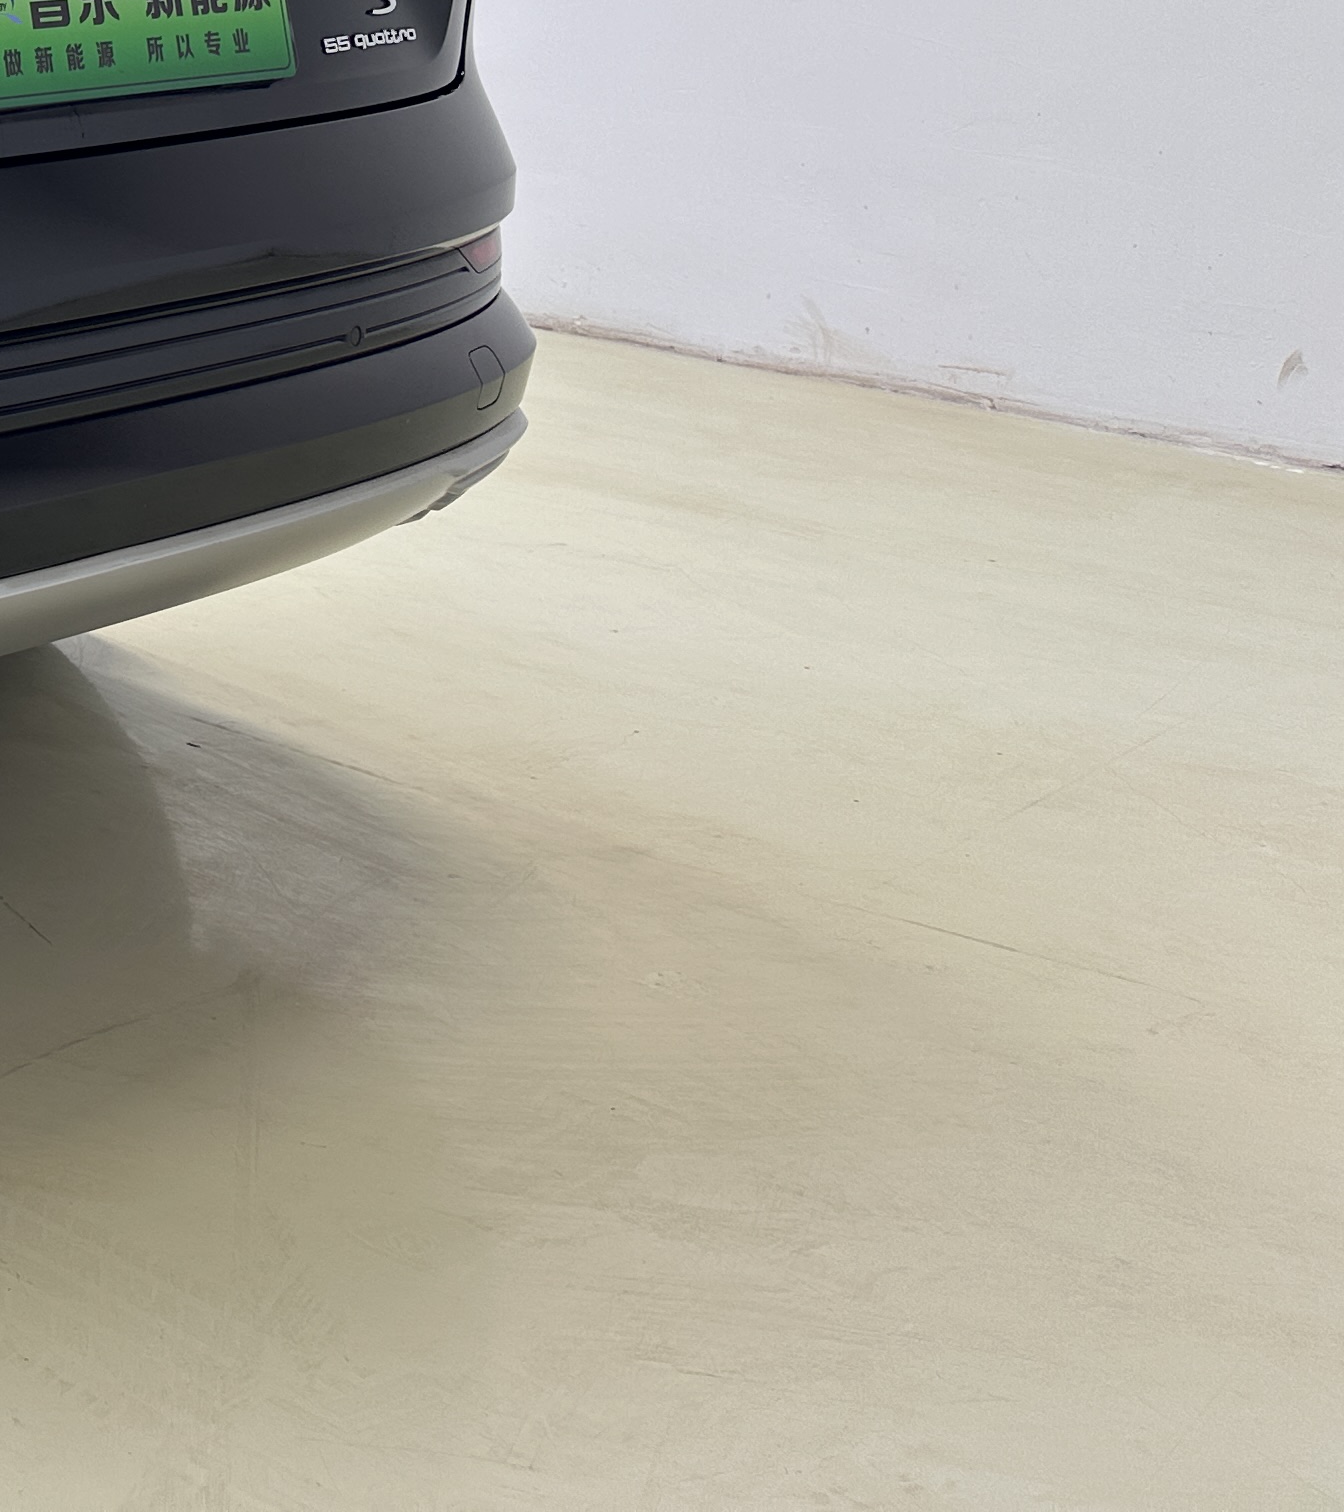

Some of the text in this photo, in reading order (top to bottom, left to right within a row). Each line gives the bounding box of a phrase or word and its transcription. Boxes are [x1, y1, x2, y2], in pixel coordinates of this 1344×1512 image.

[145, 27, 252, 64] 所以专业
[322, 28, 417, 54] 55 quattro
